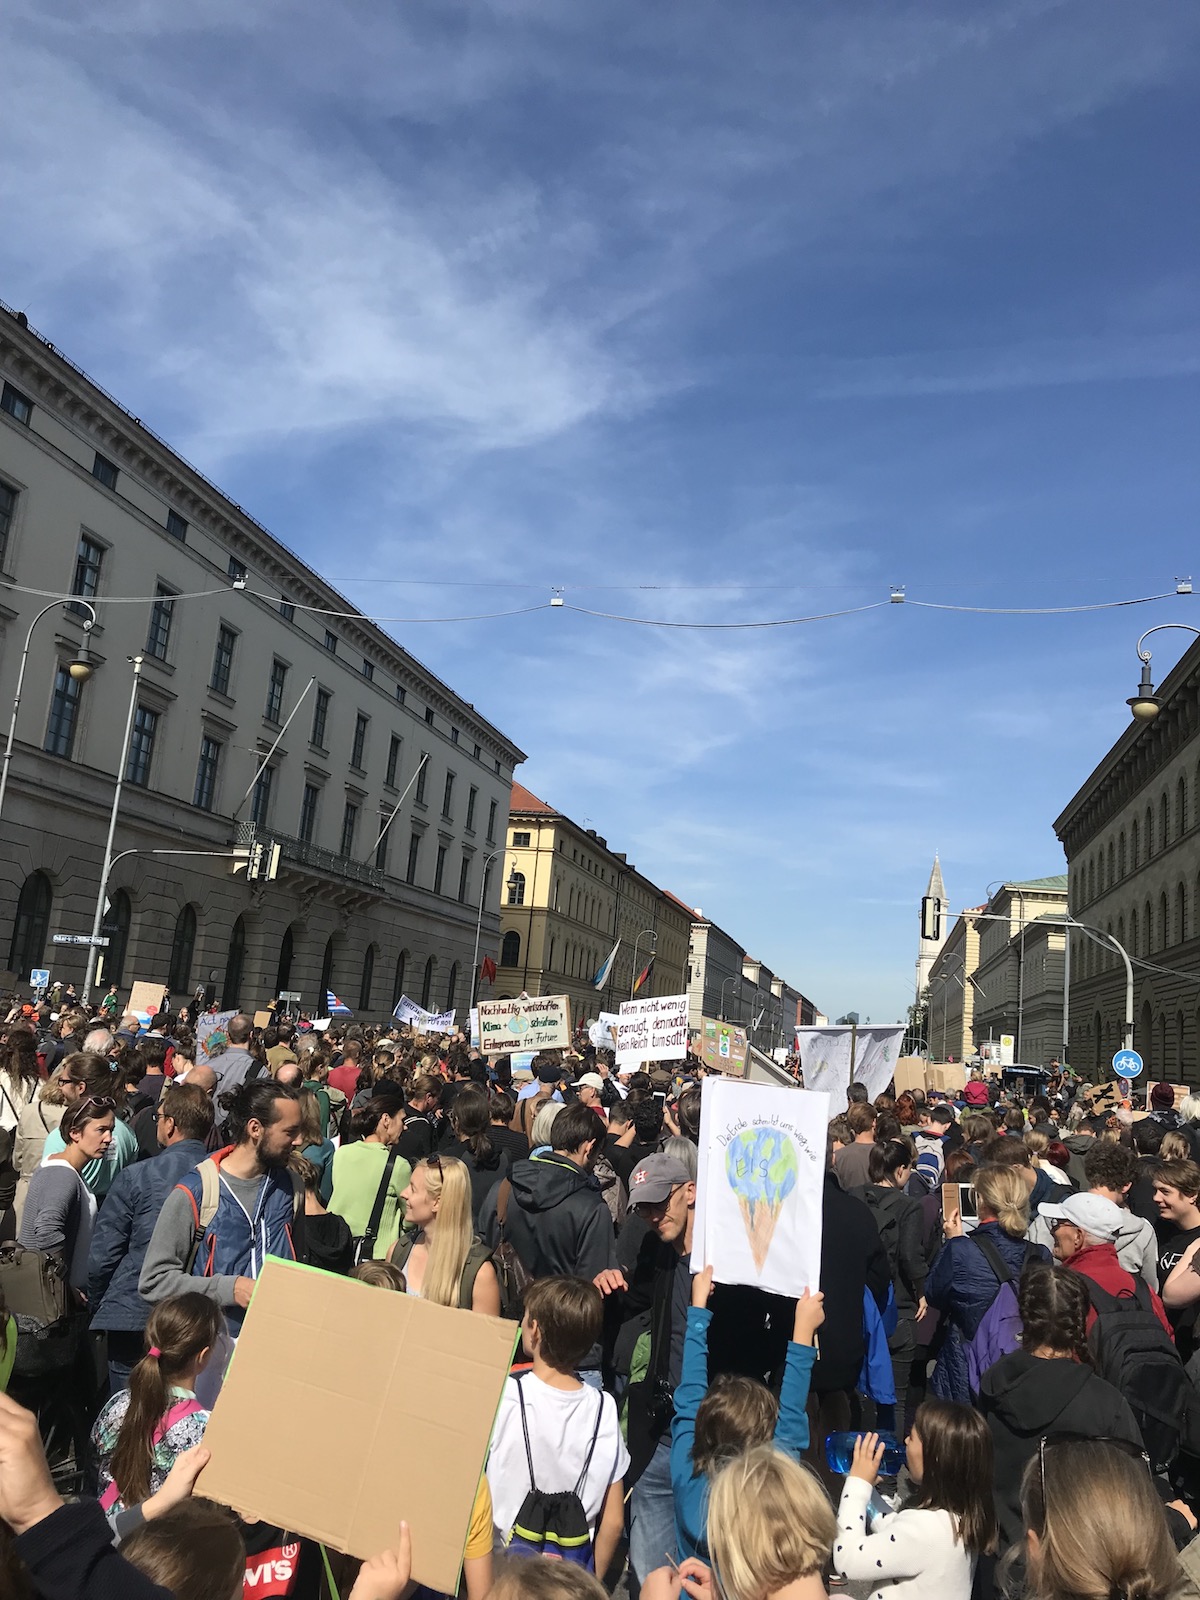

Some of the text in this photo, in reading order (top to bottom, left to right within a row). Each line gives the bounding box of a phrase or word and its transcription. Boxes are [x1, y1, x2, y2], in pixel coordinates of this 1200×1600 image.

[481, 1003, 520, 1016] Nachhaltig
[621, 1000, 686, 1015] Wem nicht wenig
[200, 1015, 216, 1026] Act
[482, 1021, 501, 1032] Klima
[618, 1017, 649, 1037] genügt,
[535, 1032, 558, 1043] Future
[726, 1117, 748, 1136] Erde
[780, 1121, 794, 1131] uns
[804, 1145, 817, 1162] wie
[735, 1158, 768, 1178] EIS
[635, 1170, 646, 1184] H
